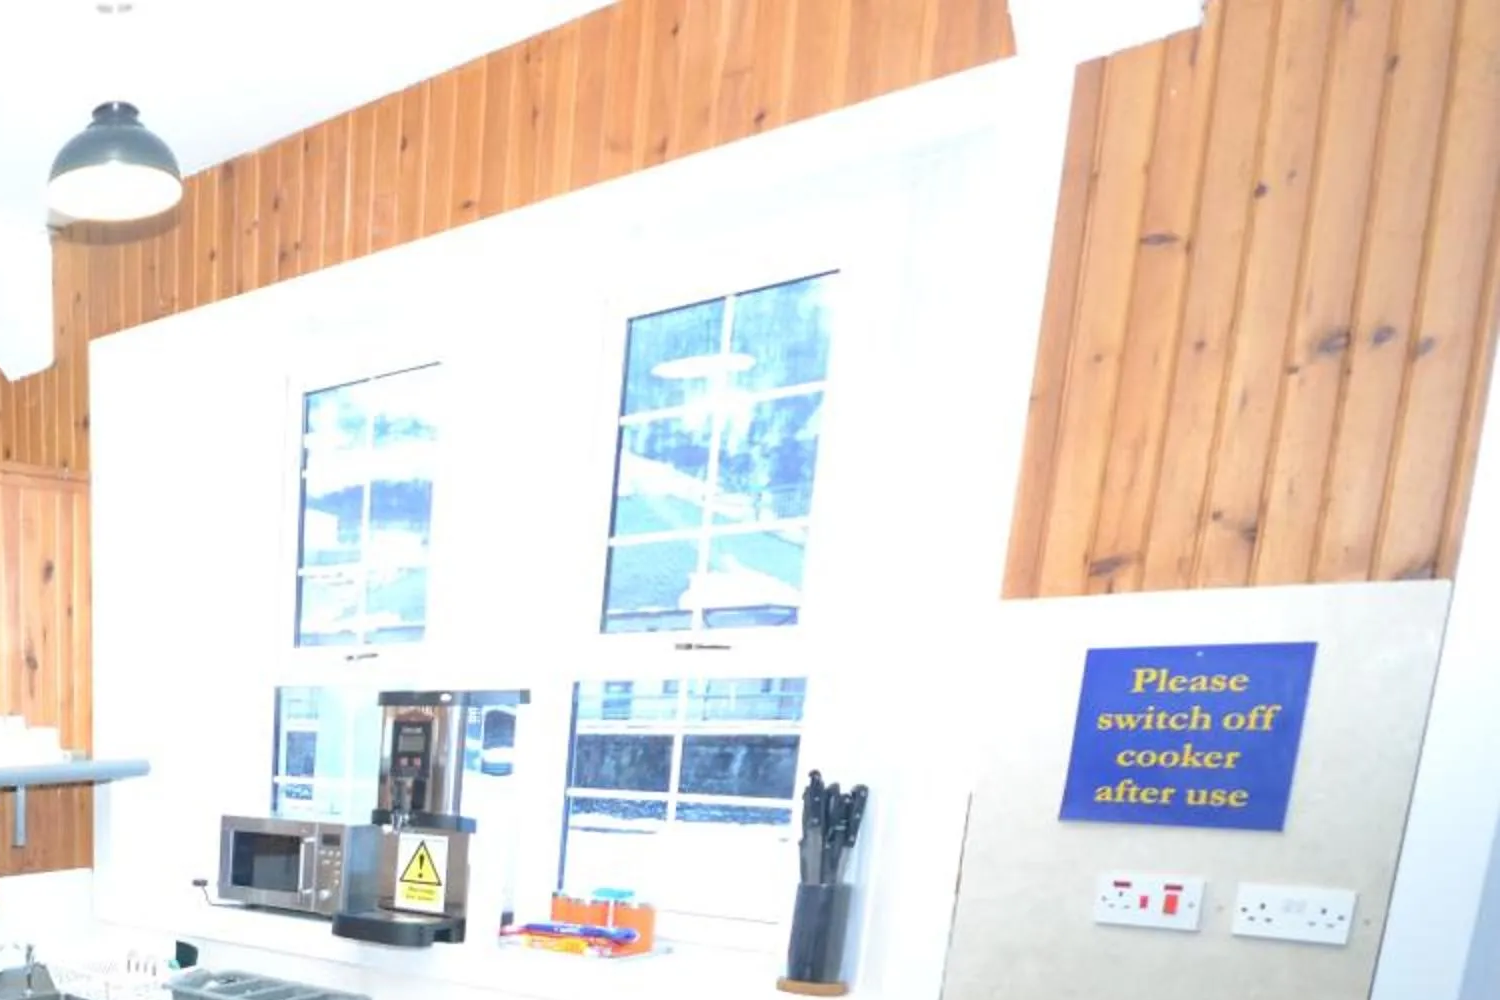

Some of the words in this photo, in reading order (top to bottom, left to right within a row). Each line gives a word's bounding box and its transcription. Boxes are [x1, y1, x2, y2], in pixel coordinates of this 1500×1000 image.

[1130, 668, 1249, 693] Please
[1097, 705, 1211, 730] switch
[1222, 704, 1282, 731] off
[1116, 744, 1241, 768] cooker
[1094, 779, 1176, 804] after
[1186, 788, 1248, 807] use
